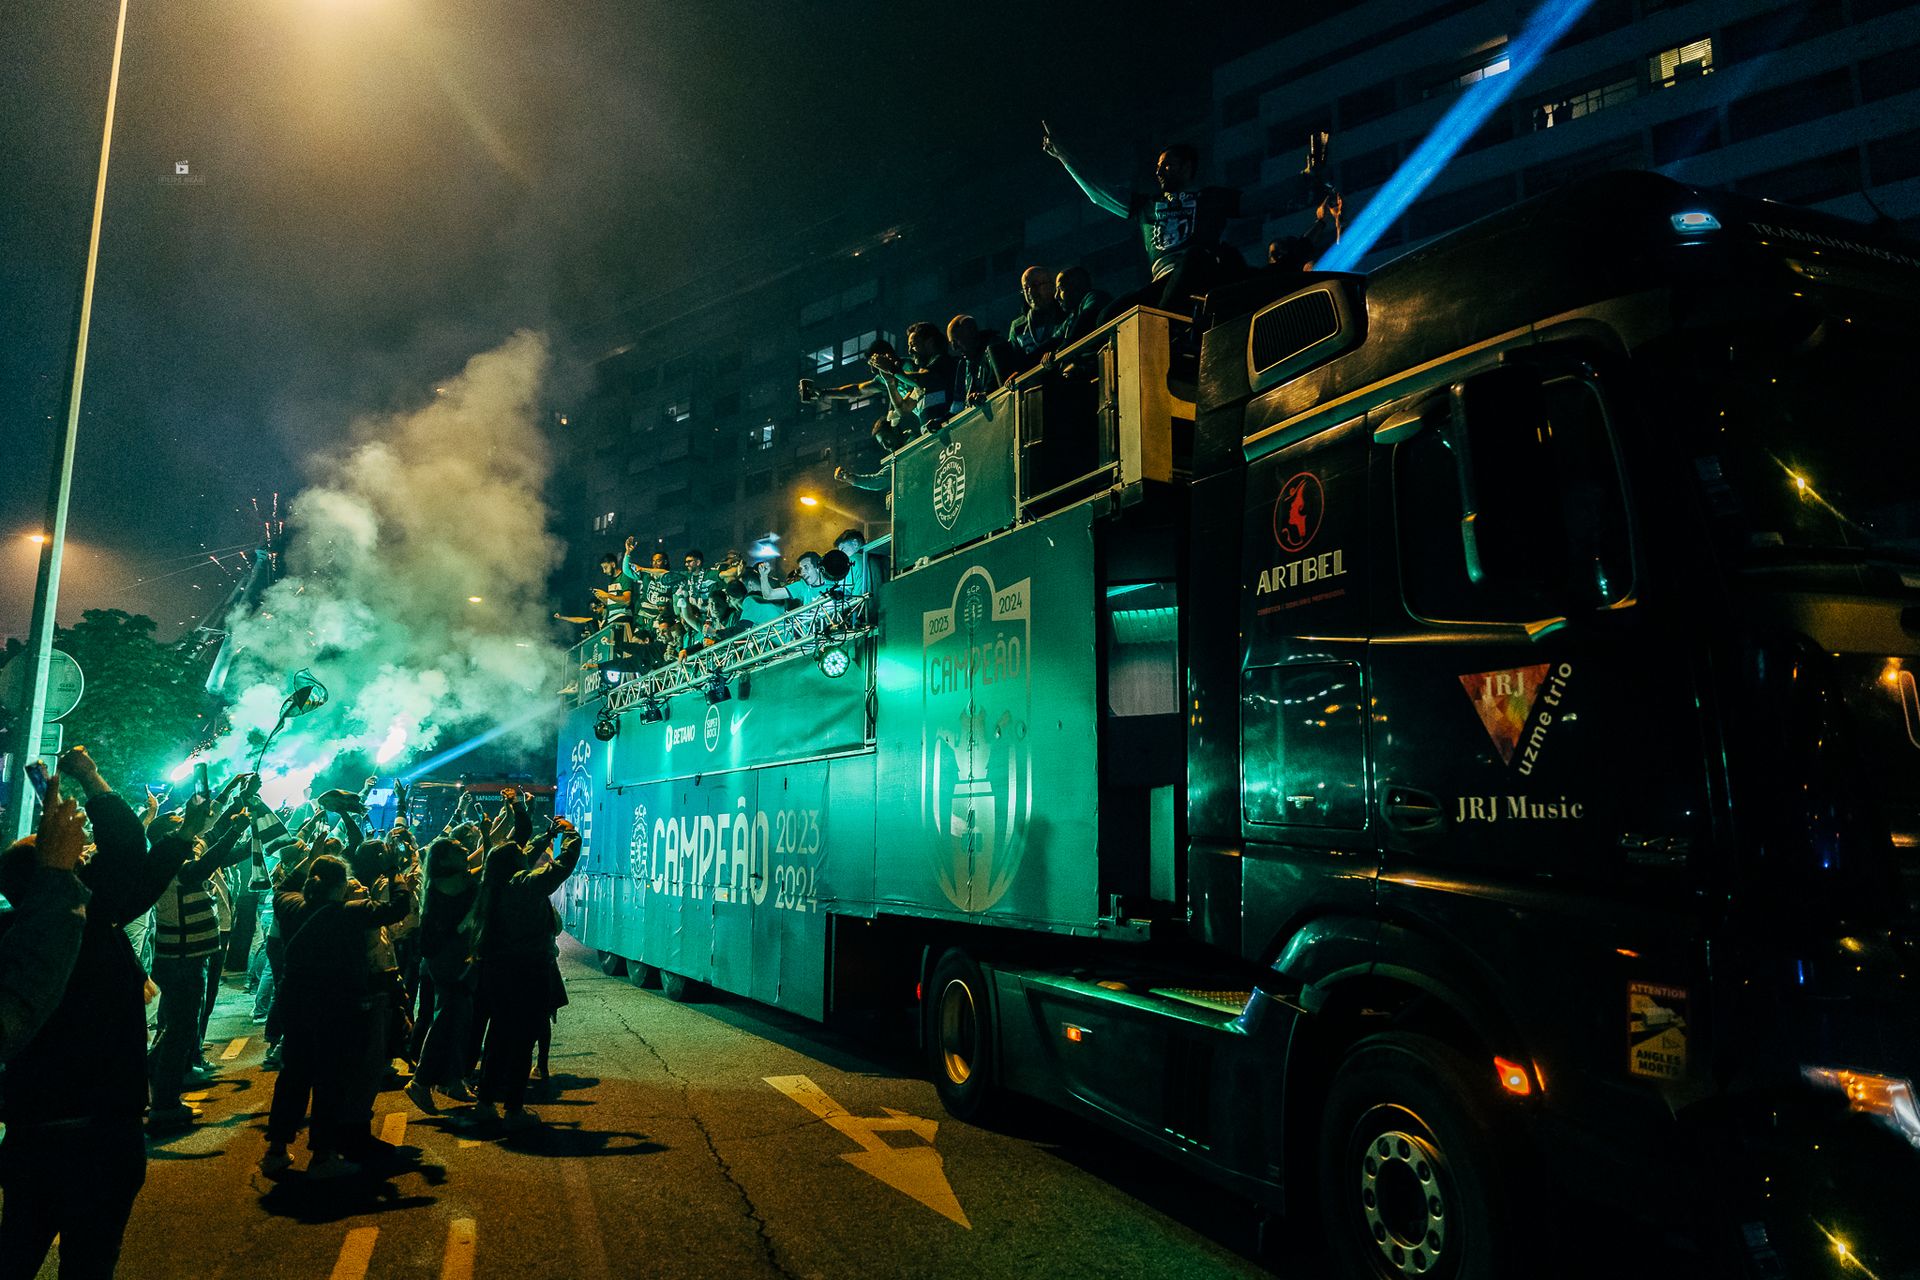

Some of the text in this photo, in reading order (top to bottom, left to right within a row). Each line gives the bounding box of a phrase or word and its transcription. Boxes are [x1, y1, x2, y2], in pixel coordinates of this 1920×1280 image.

[939, 442, 961, 464] SCP
[1256, 549, 1348, 596] ARTBEL
[966, 585, 980, 596] SCP
[998, 592, 1022, 614] 2024
[928, 615, 949, 635] 2023
[930, 632, 1021, 695] CAMPEÃO
[1483, 672, 1525, 698] JRJ
[1518, 662, 1573, 776] uzme trio
[673, 725, 696, 745] BETANO
[571, 739, 591, 771] SCP
[1456, 795, 1584, 823] JRJ Music
[775, 809, 820, 855] 2023
[651, 796, 769, 906] CAMPEÃO
[774, 864, 818, 914] 2024
[1630, 983, 1687, 999] ATTENTION
[1636, 1049, 1680, 1066] ANGLES
[1638, 1060, 1679, 1077] MORTS
